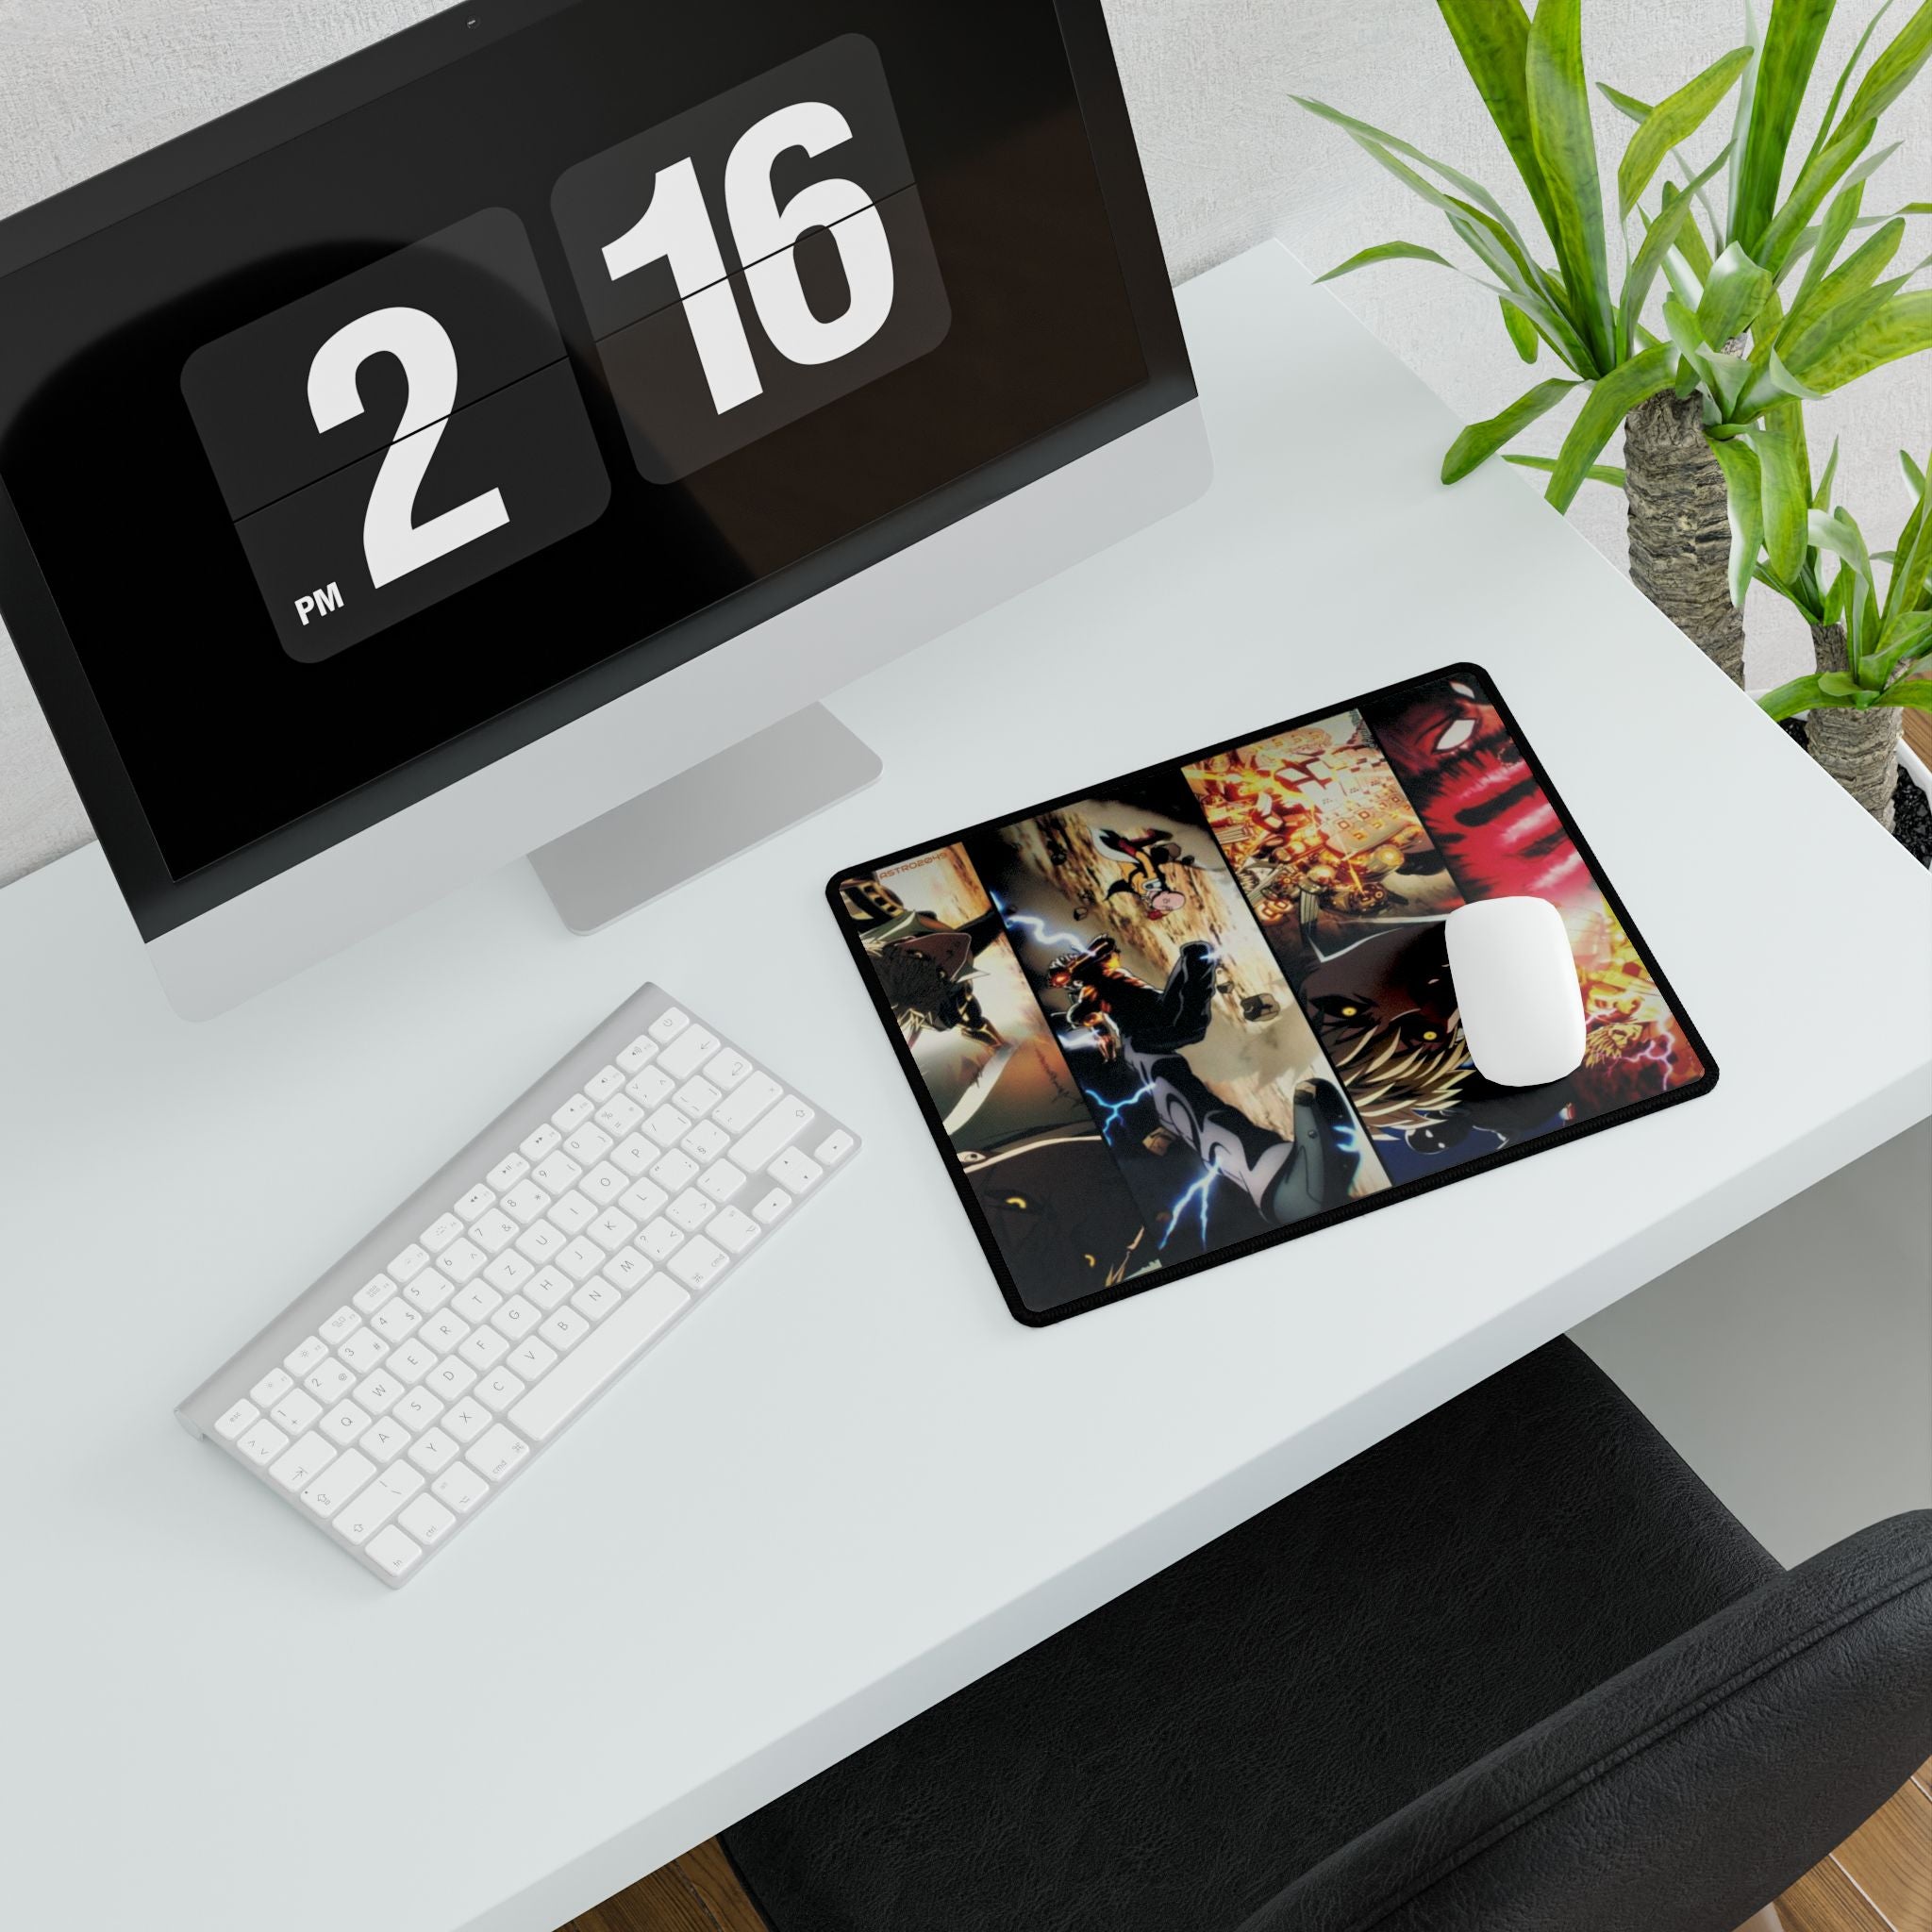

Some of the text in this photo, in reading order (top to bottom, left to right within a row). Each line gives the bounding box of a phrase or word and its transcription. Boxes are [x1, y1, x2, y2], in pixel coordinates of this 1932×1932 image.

[601, 101, 895, 415] 16
[307, 307, 510, 590] 2
[294, 581, 344, 626] PM
[571, 1141, 579, 1149] 0
[631, 1149, 640, 1158] P
[601, 1177, 610, 1186] O
[508, 1199, 516, 1208] 8
[605, 1222, 615, 1230] K
[475, 1228, 483, 1237] 7
[535, 1235, 547, 1245] U
[575, 1251, 584, 1259] J
[444, 1258, 452, 1267] 6
[621, 1260, 634, 1272] M
[505, 1265, 516, 1275] Z
[540, 1279, 553, 1291] H
[410, 1288, 420, 1296] 5
[589, 1291, 601, 1301] N
[509, 1310, 520, 1319] G
[378, 1317, 387, 1326] 4
[558, 1322, 568, 1331] B
[476, 1341, 485, 1349] F
[345, 1348, 355, 1357] 3
[525, 1351, 534, 1359] V
[408, 1356, 418, 1365] E
[443, 1372, 454, 1381] D
[311, 1378, 322, 1387] 2
[492, 1382, 504, 1391] C
[372, 1385, 385, 1396] W
[411, 1402, 422, 1410] S
[341, 1418, 353, 1426] Q
[459, 1412, 472, 1424] X
[379, 1434, 390, 1443] A
[426, 1443, 437, 1452] Y
[492, 1459, 507, 1474] cmd
[425, 1525, 437, 1538] ctrl
[392, 1559, 402, 1568] fn
